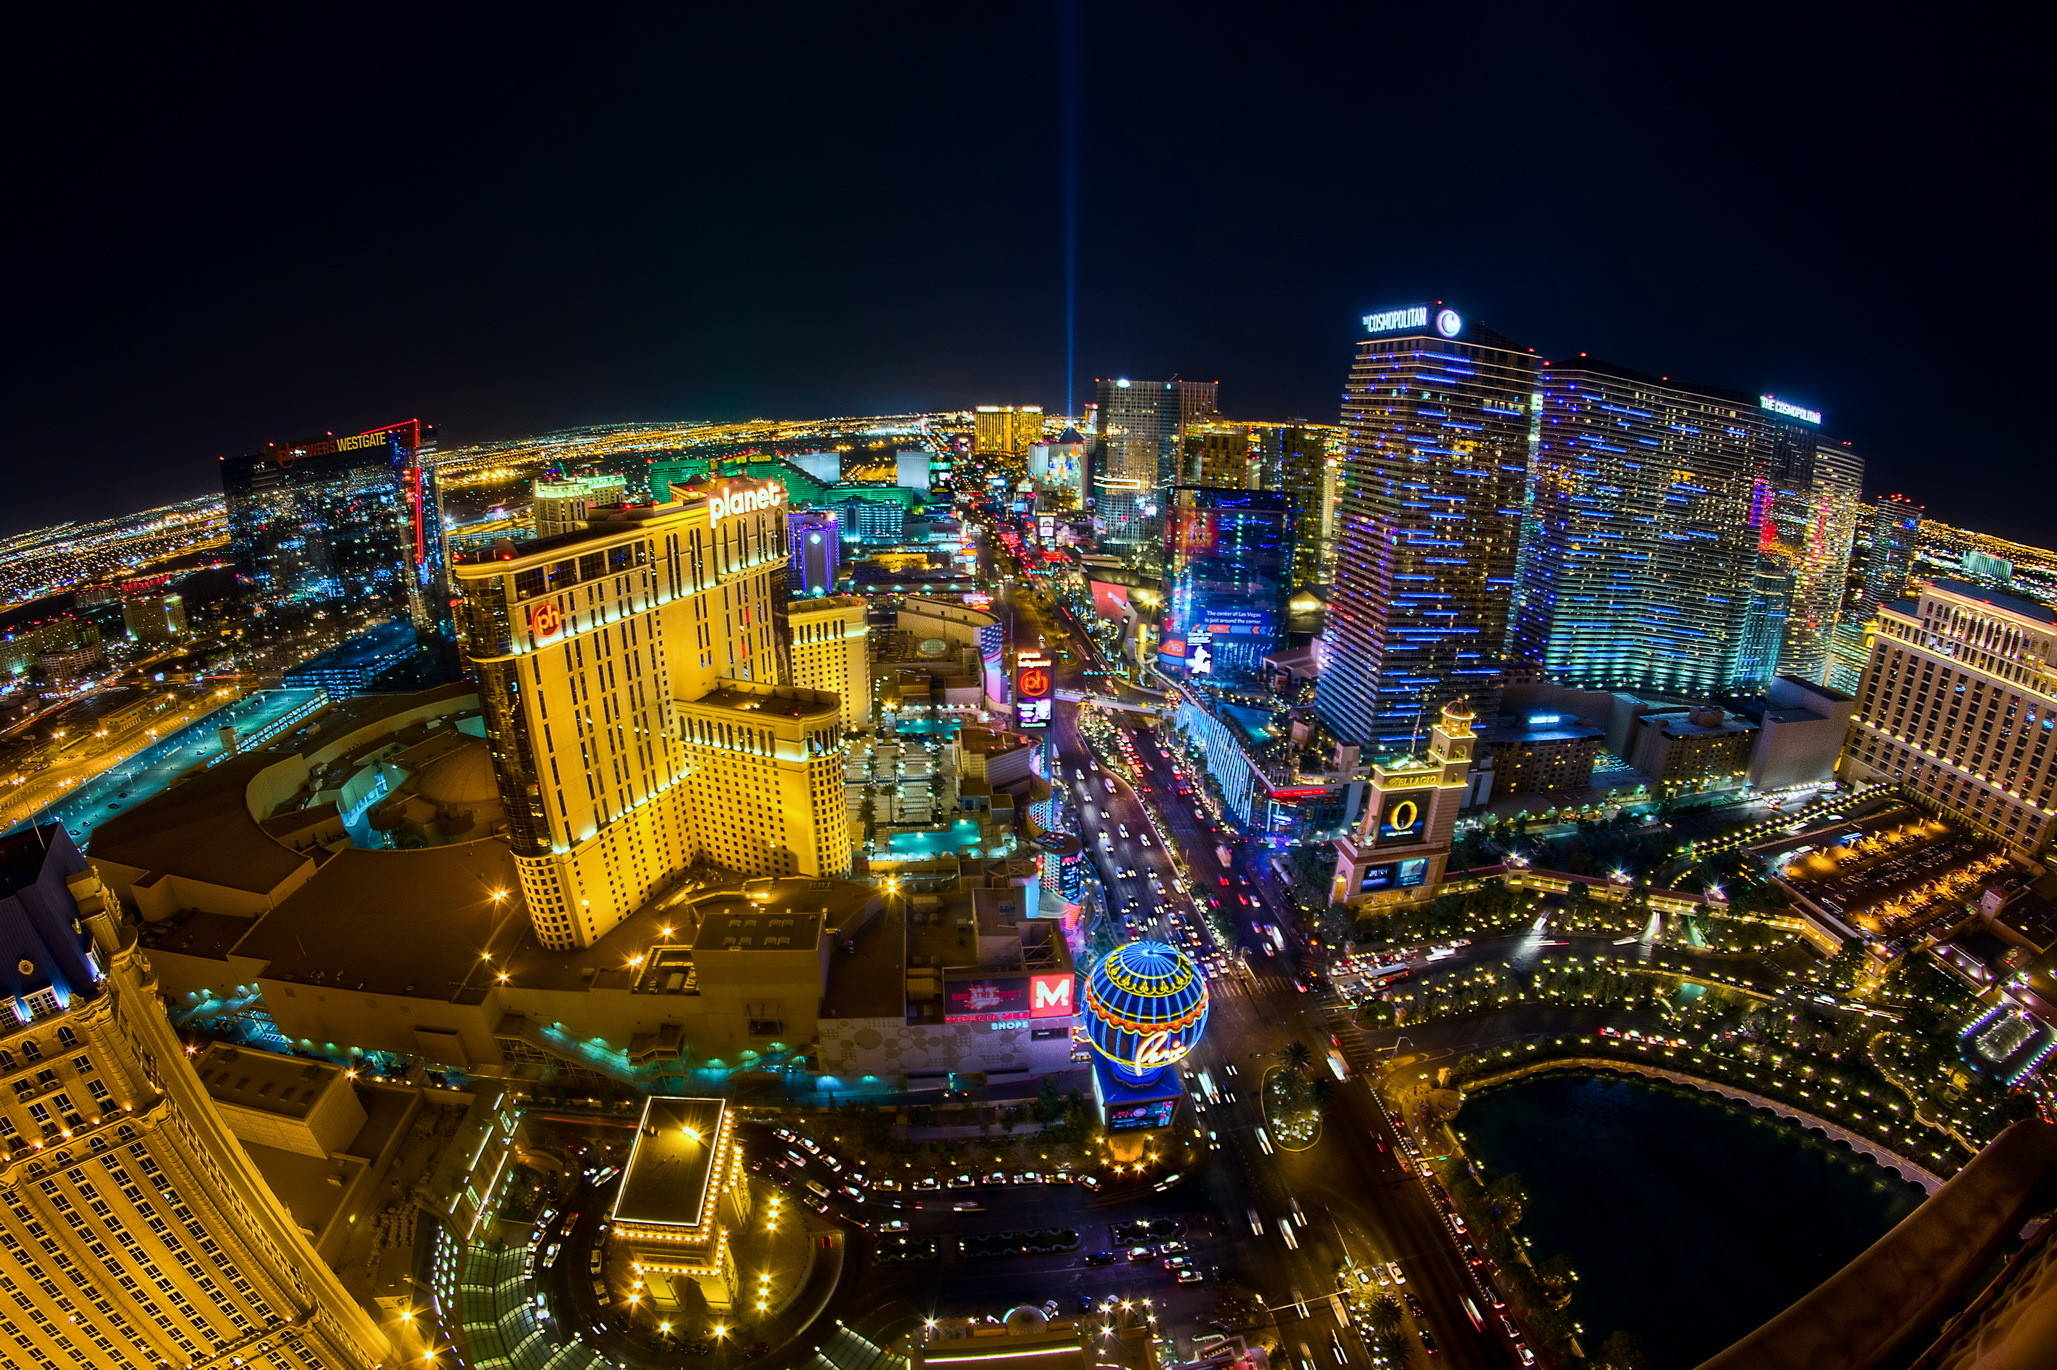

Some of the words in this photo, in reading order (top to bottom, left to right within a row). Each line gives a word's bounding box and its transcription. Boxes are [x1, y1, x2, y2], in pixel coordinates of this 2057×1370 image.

[1368, 308, 1427, 332] COSMOPOLITAN
[1760, 395, 1775, 411] THE
[1775, 400, 1821, 424] COSMOPOLITAN
[337, 431, 387, 452] WESTGATE
[709, 482, 781, 529] planet
[536, 605, 560, 635] ph
[1389, 775, 1436, 786] BELLAGIO
[1390, 800, 1418, 831] O
[1036, 979, 1070, 1008] M
[991, 1021, 1029, 1031] SHOPS
[1134, 1030, 1188, 1077] Paris
